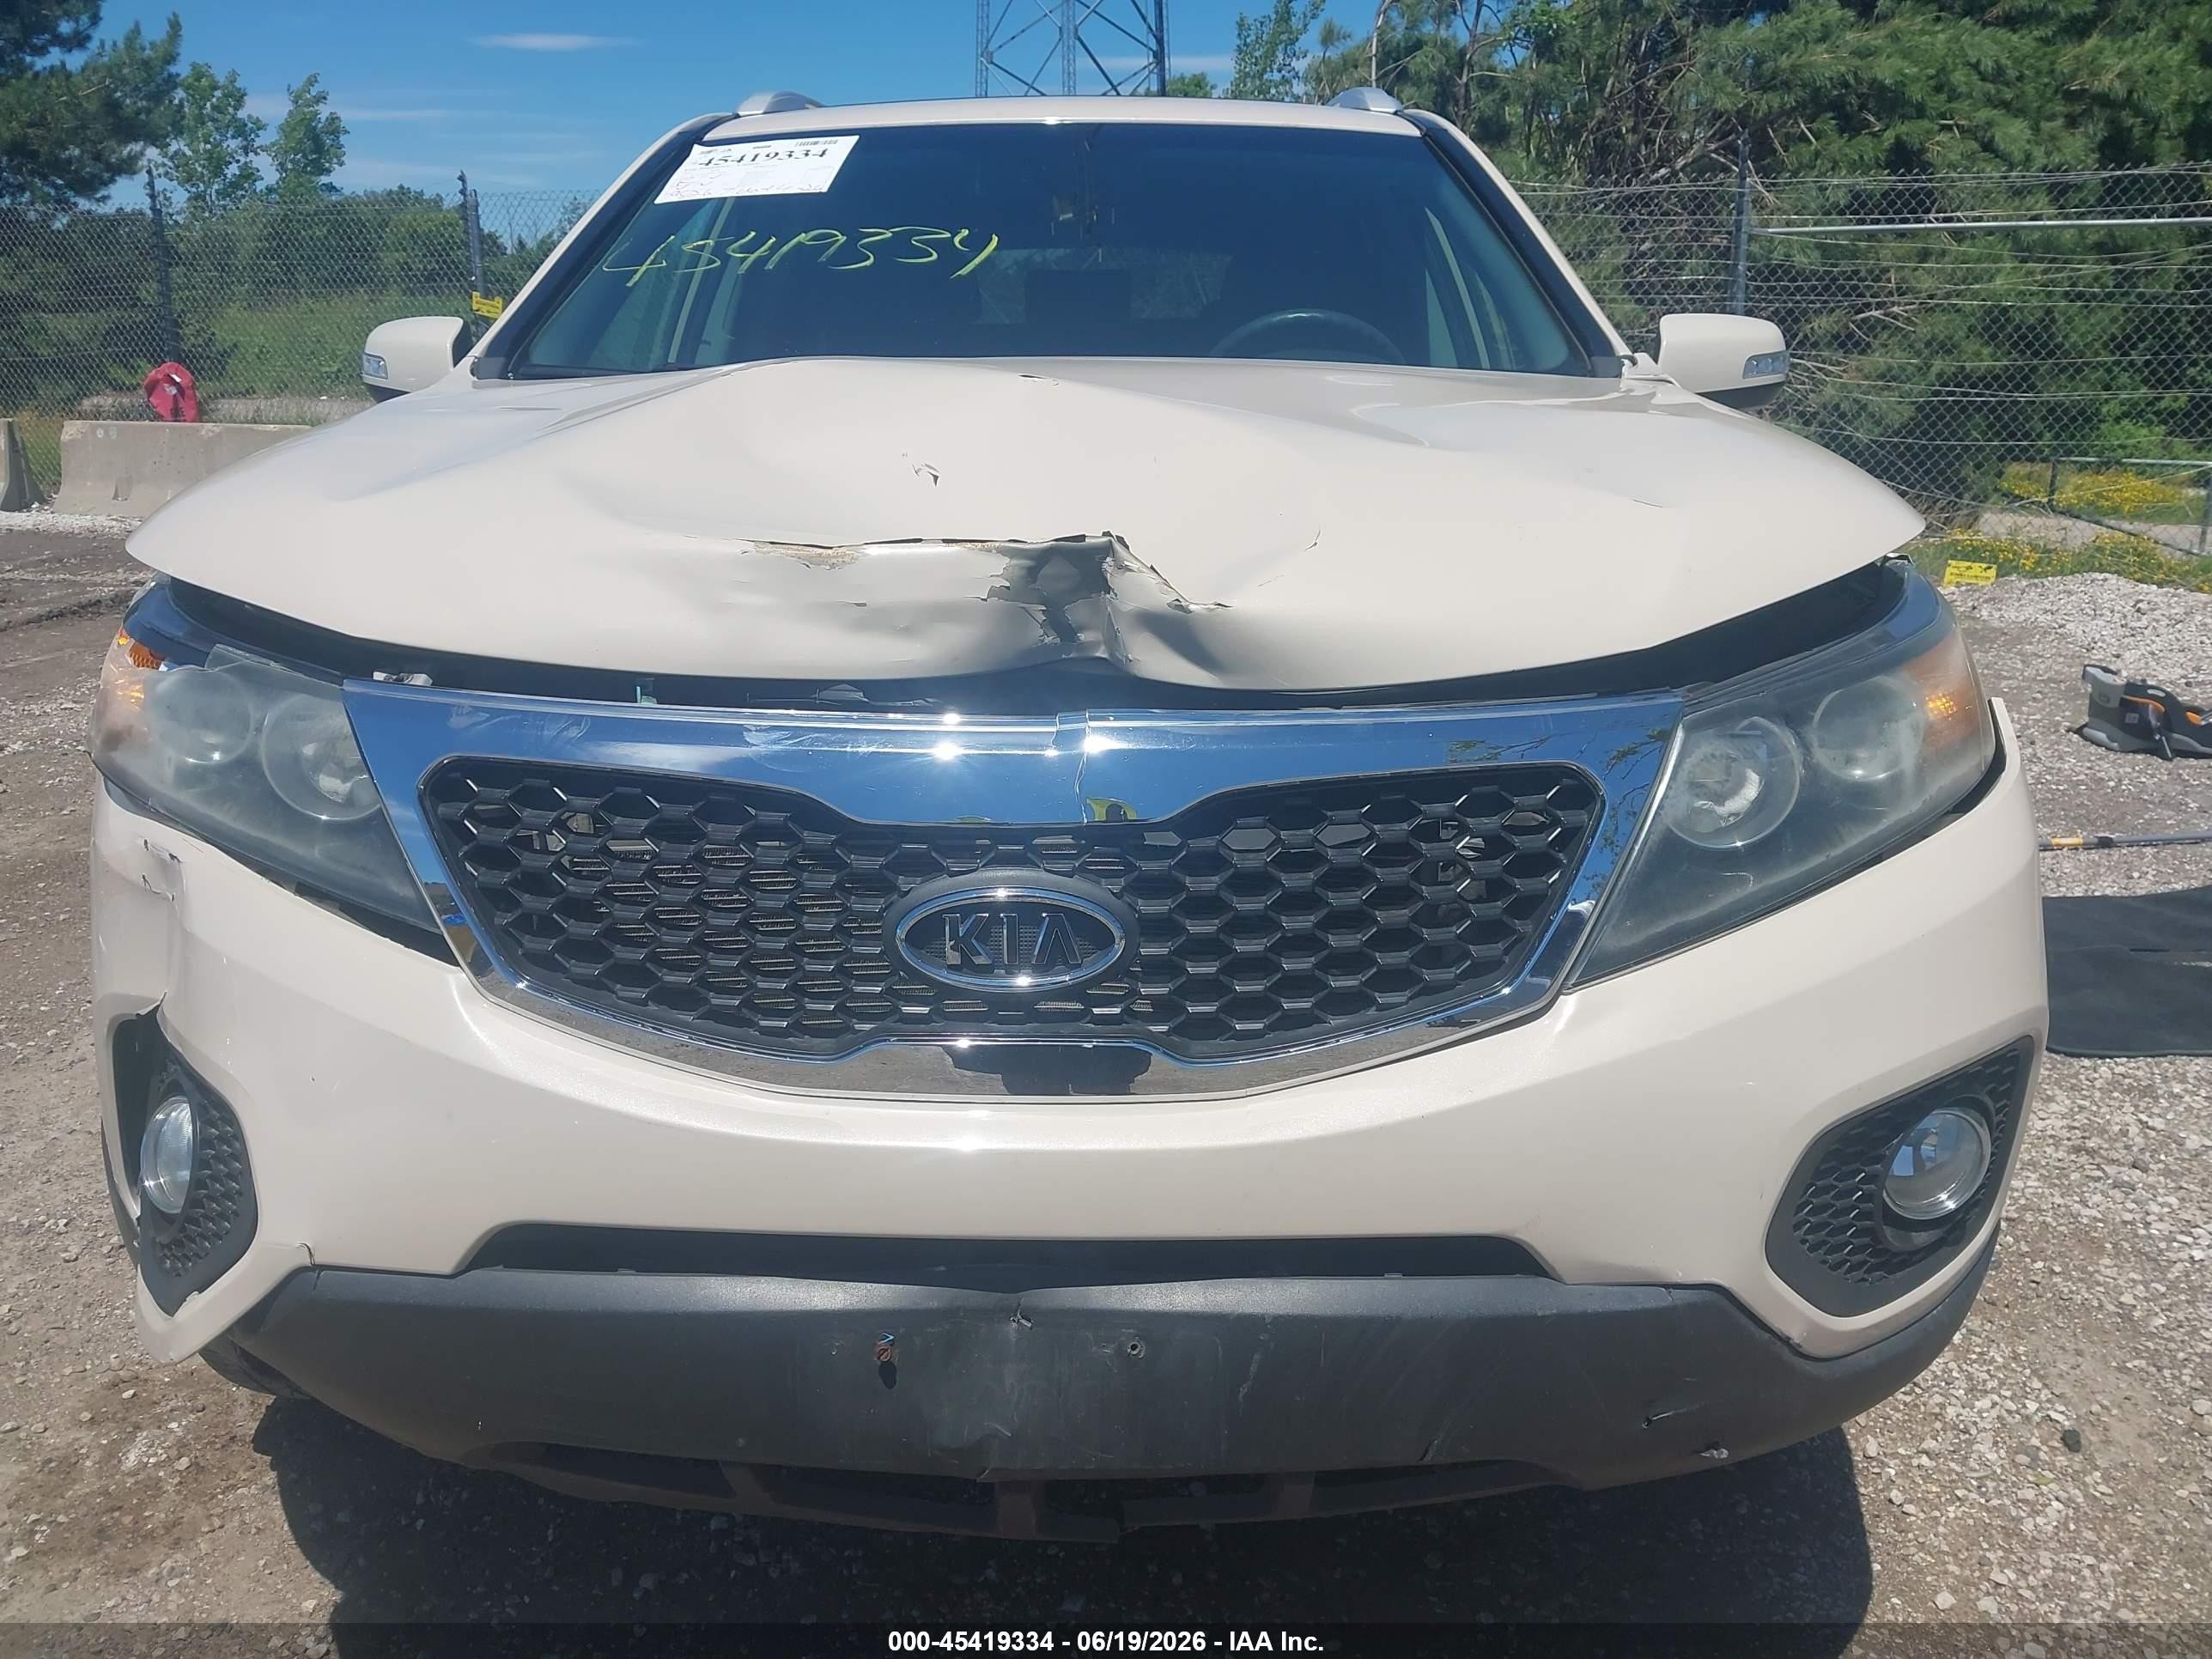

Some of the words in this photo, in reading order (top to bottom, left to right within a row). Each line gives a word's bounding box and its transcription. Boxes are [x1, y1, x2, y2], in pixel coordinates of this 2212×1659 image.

[698, 147, 829, 167] 45419334
[602, 226, 999, 287] 45419334
[942, 913, 1082, 965] KIA
